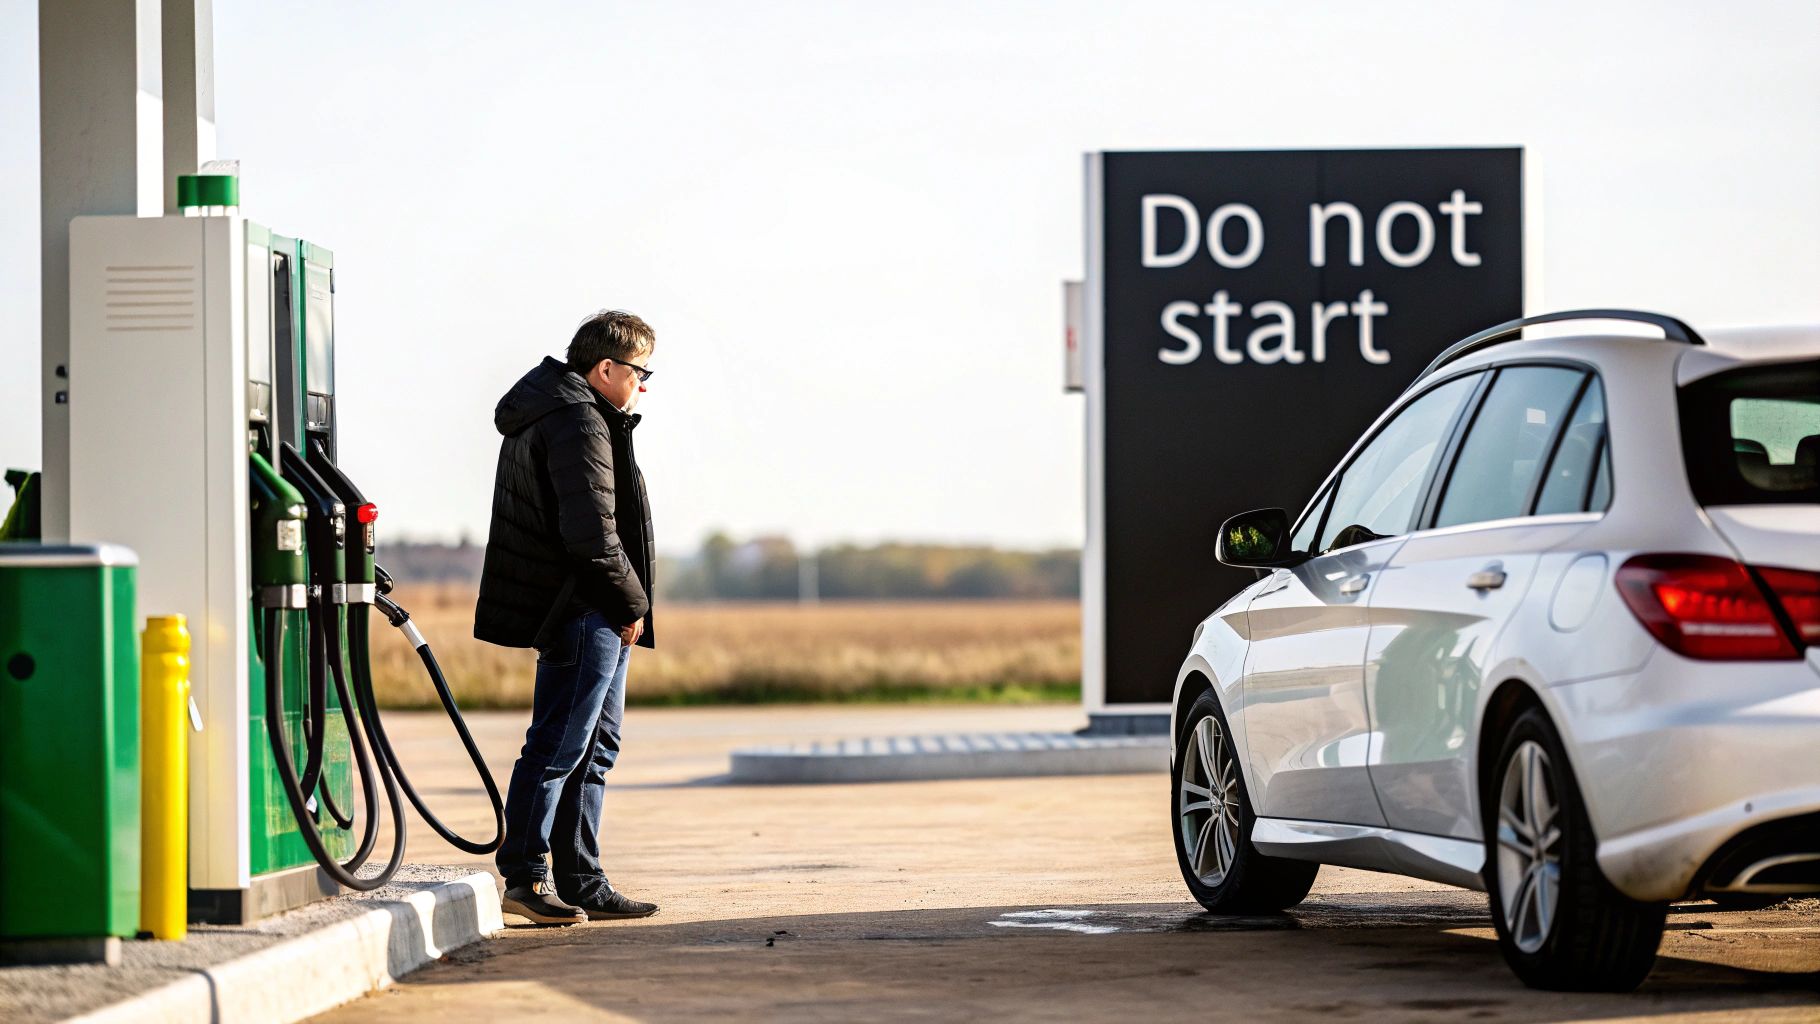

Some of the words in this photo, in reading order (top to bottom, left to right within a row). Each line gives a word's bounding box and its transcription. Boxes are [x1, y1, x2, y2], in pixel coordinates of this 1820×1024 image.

[1141, 194, 1264, 268] Do
[1310, 189, 1483, 267] not
[1158, 289, 1390, 365] start
